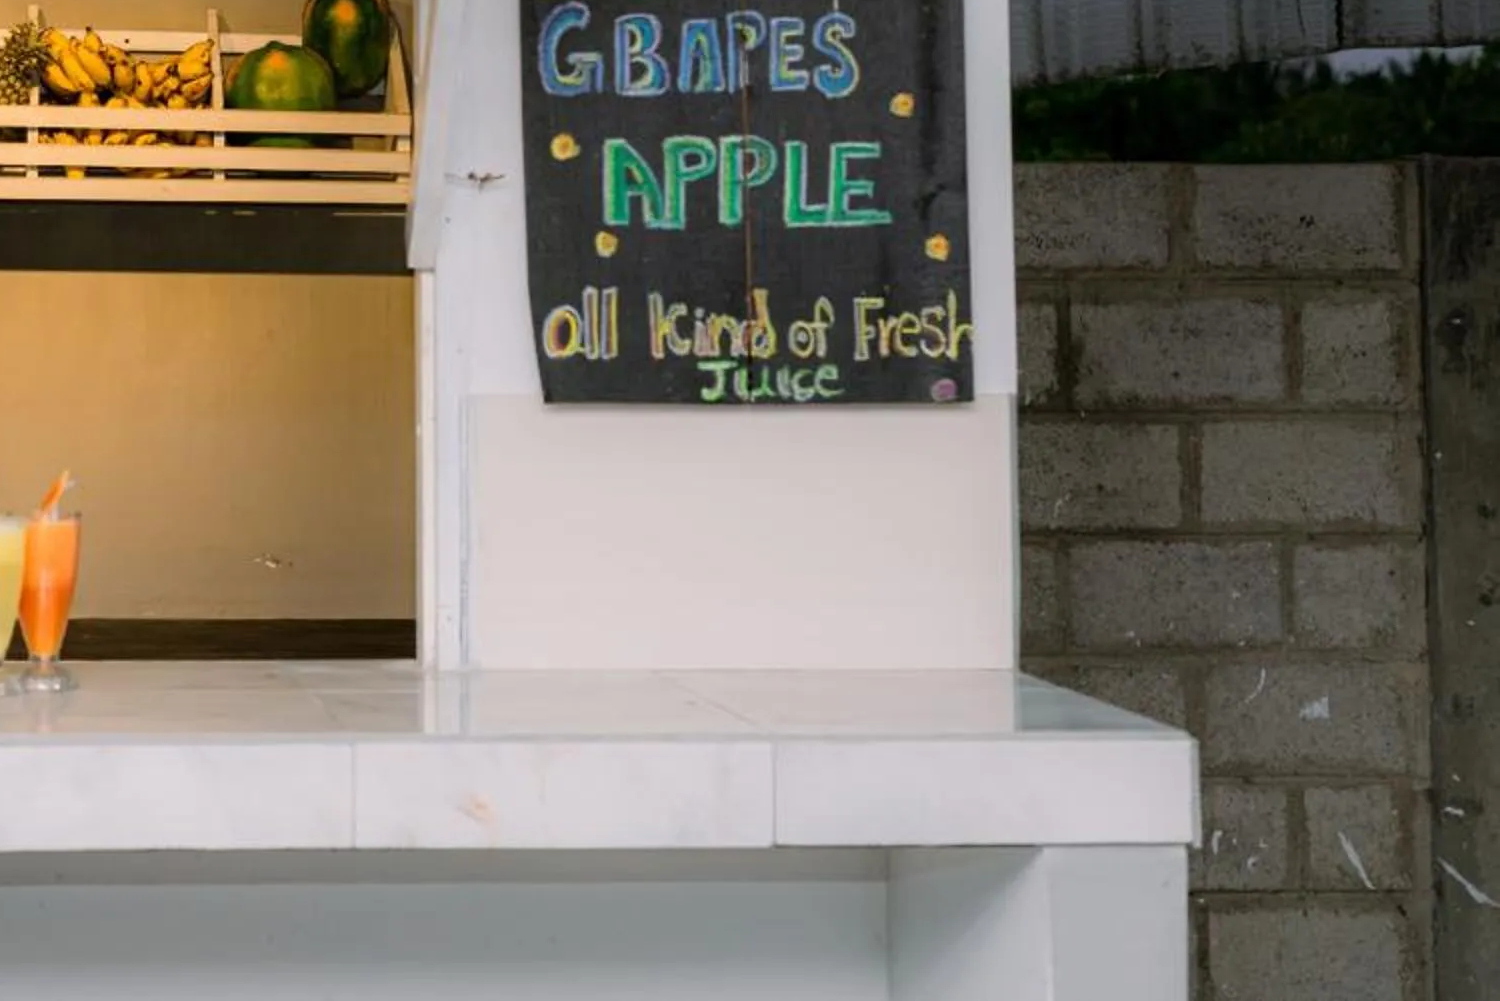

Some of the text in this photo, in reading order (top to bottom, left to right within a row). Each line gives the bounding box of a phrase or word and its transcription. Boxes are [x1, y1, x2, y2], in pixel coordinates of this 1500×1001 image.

[602, 135, 892, 230] APPLE
[789, 297, 835, 358] of
[854, 290, 976, 361] Fresh
